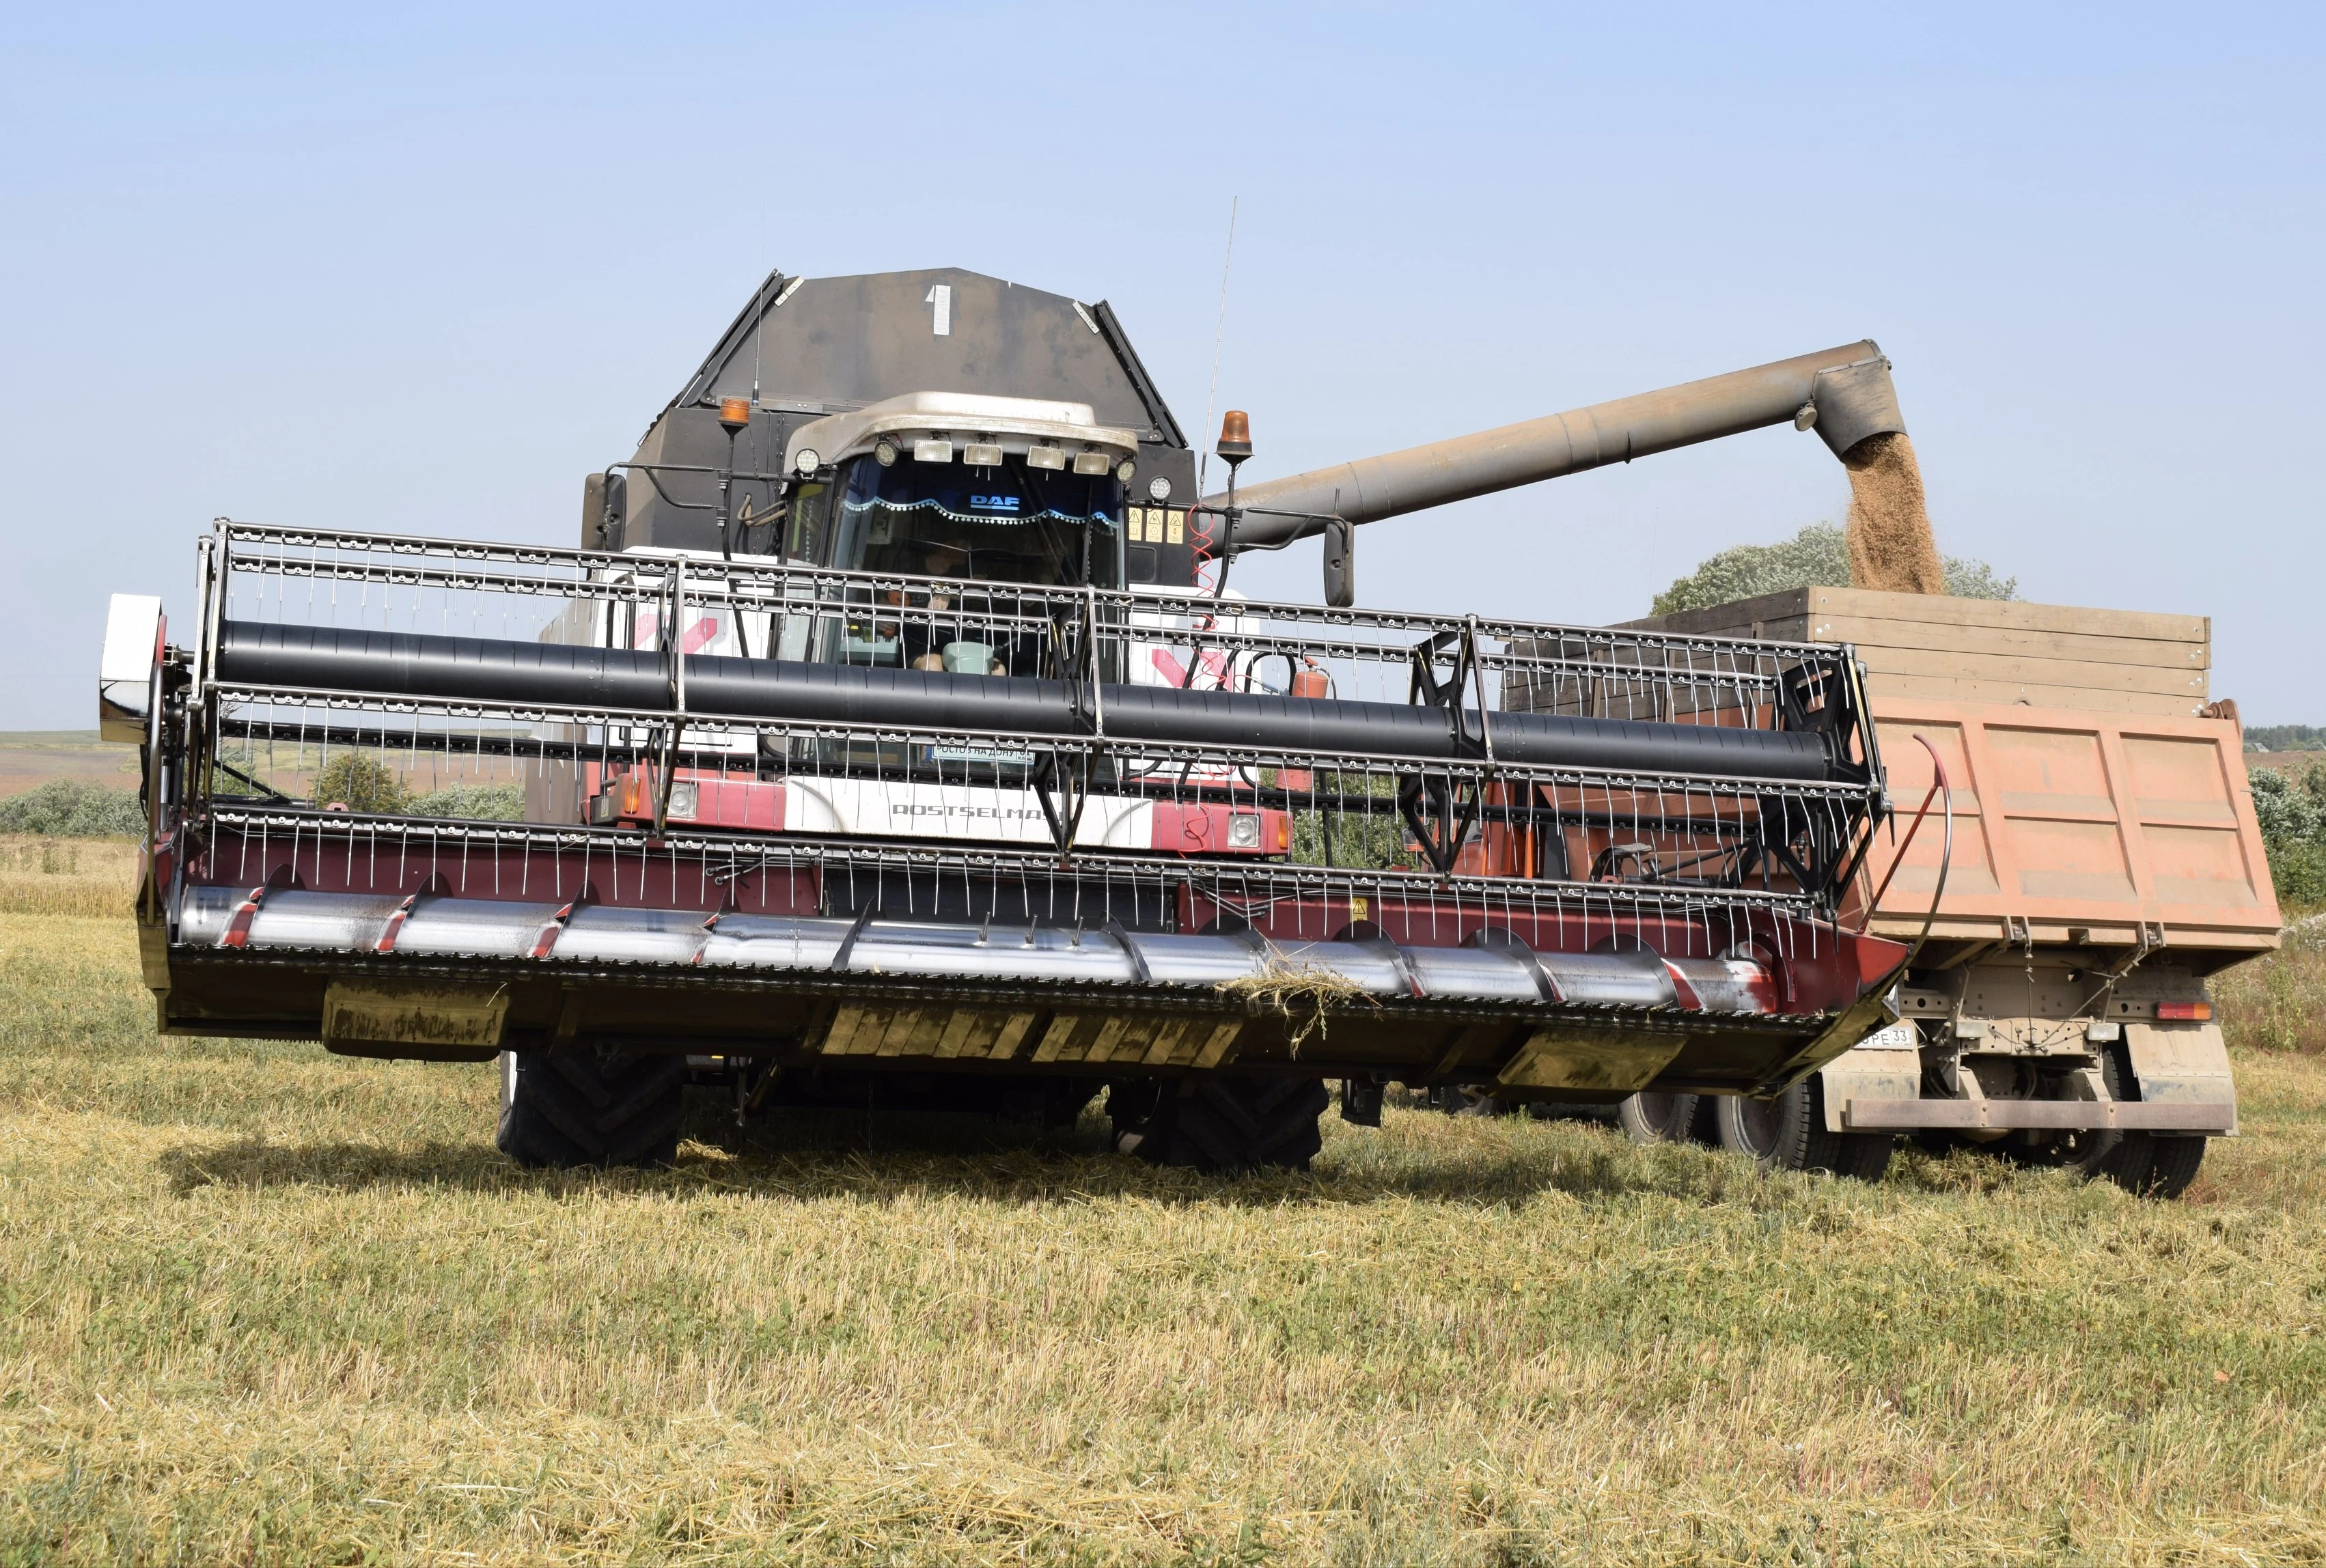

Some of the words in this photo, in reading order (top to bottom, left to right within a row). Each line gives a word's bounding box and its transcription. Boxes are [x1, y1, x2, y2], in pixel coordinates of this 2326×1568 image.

[925, 285, 951, 335] 1
[971, 495, 1020, 506] DAF
[1892, 1030, 1907, 1041] 33
